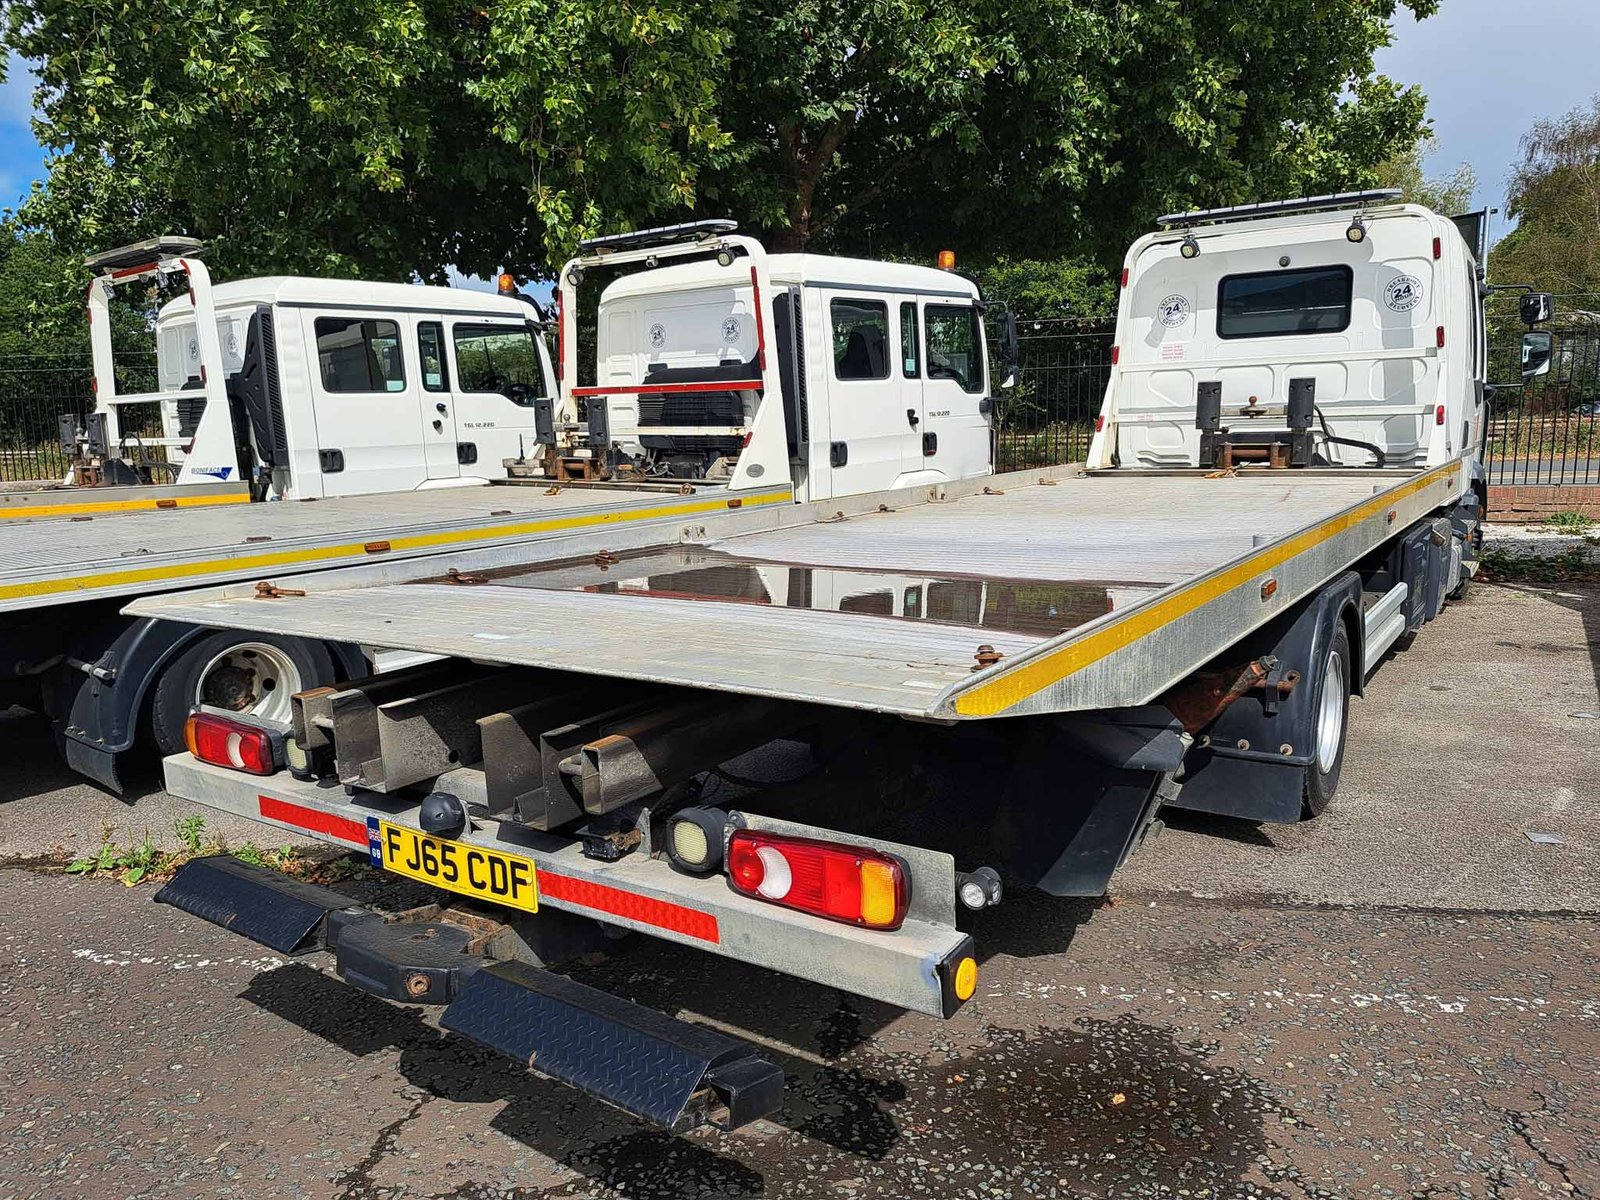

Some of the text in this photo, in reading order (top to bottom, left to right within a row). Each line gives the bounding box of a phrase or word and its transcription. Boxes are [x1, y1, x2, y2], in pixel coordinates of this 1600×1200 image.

[1393, 284, 1411, 299] 24
[1395, 292, 1413, 302] HOUR
[1165, 303, 1180, 316] 24
[726, 324, 736, 335] 24
[371, 847, 382, 859] GB
[386, 827, 530, 900] FJ65 CDF
